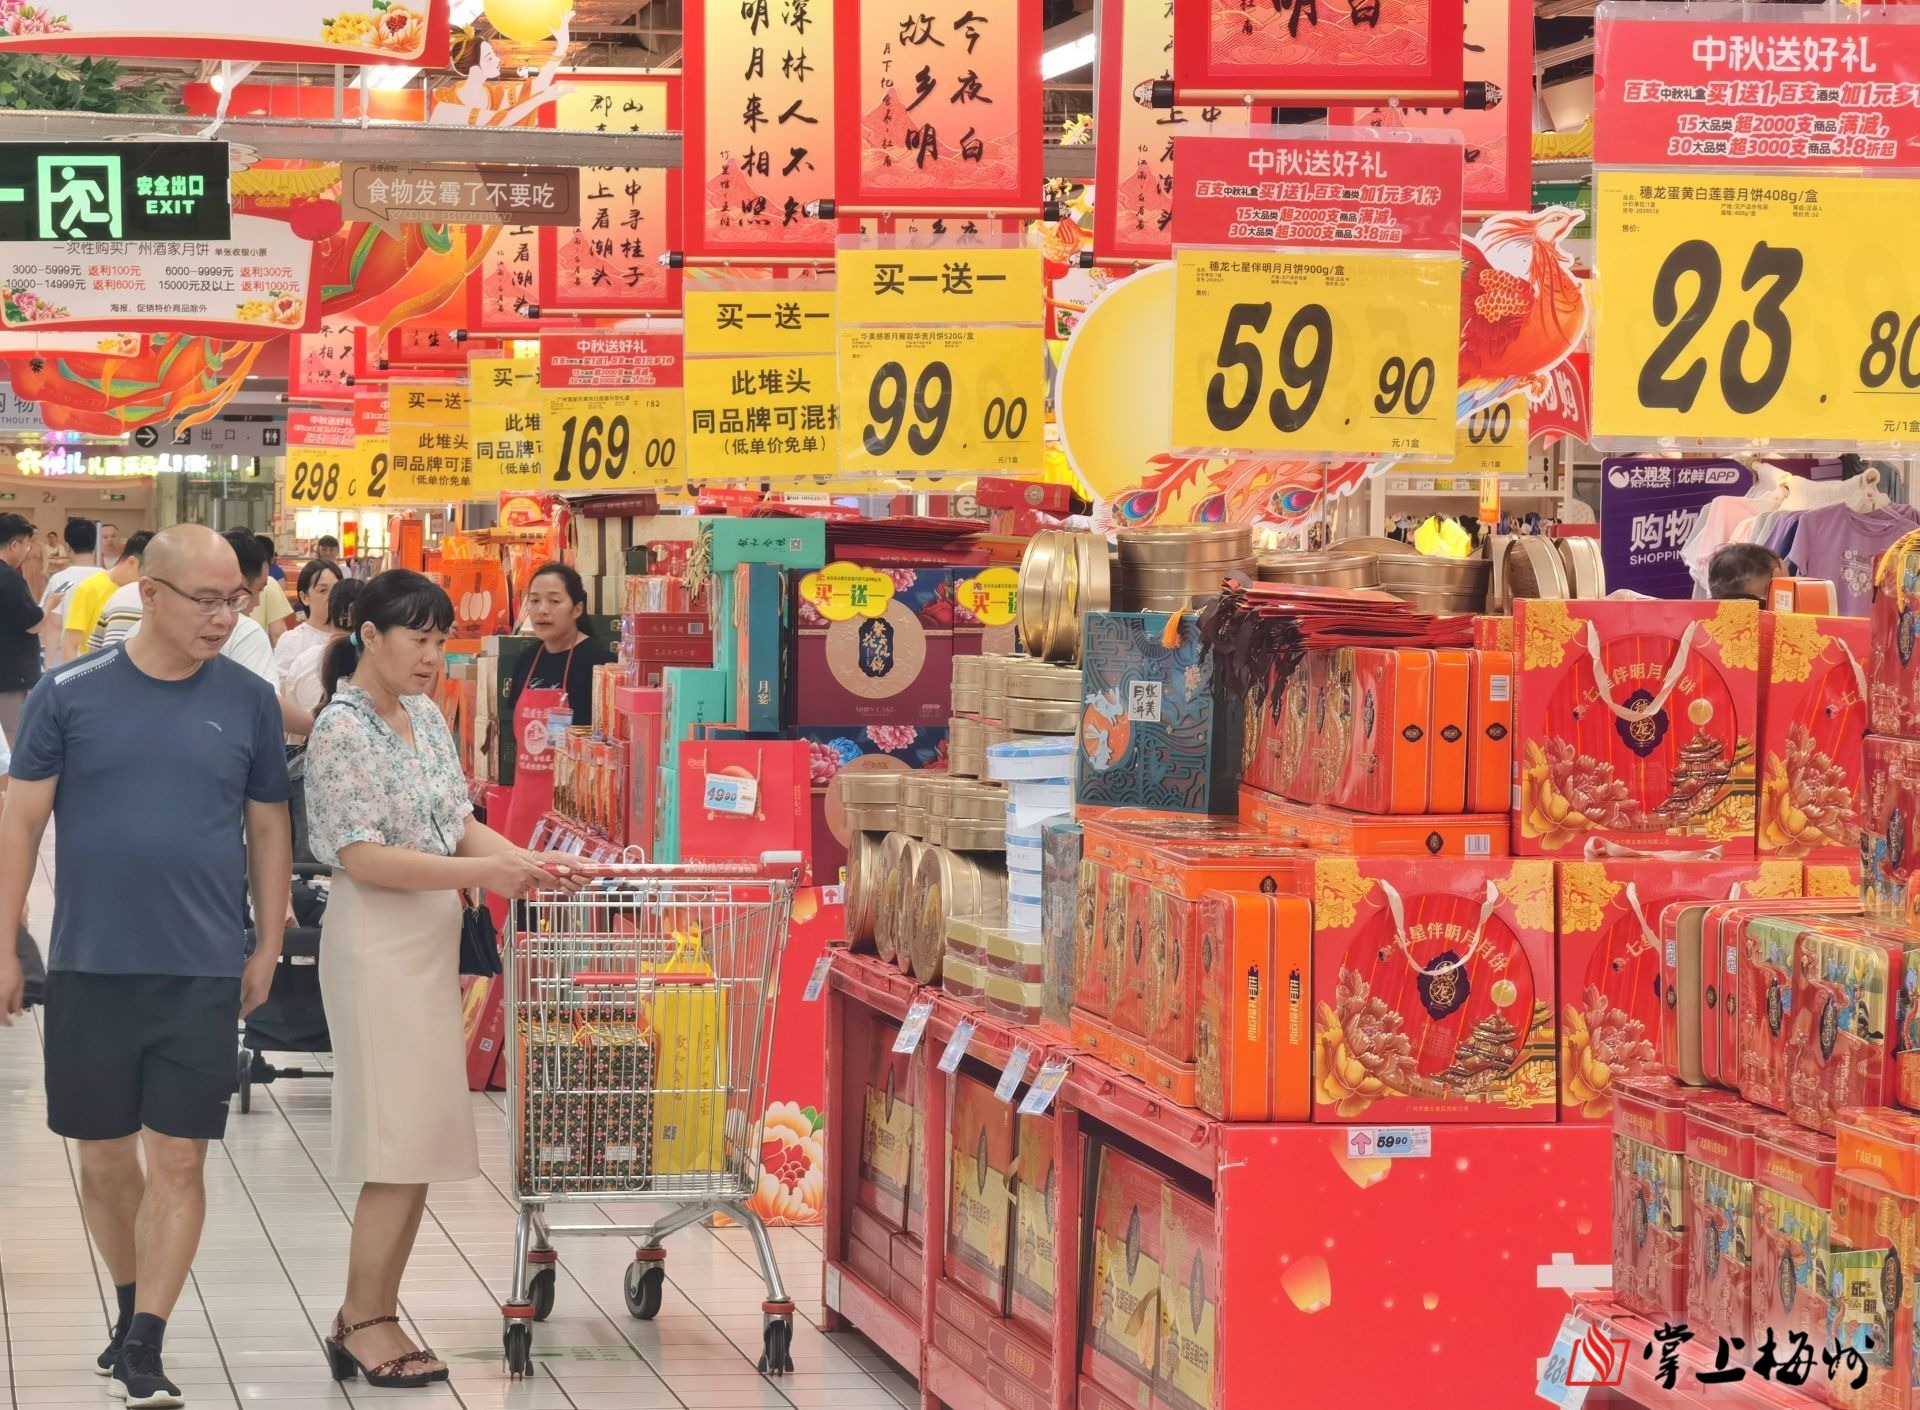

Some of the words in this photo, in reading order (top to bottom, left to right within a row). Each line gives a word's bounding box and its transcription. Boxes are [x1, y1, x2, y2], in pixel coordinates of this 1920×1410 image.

[1692, 35, 1877, 73] 中秋送好礼
[899, 13, 945, 169] 故乡明
[950, 11, 993, 163] 今夜白
[1249, 148, 1388, 179] 中秋送好礼
[137, 175, 204, 196] 安全出口
[367, 177, 555, 209] 食物发霉了不要吃
[1640, 185, 1818, 204] 穗龙蛋黄白莲蓉月饼408g/盒
[146, 201, 195, 214] EXIT
[442, 210, 513, 223] KNOW
[1622, 224, 1640, 232] 售价:
[53, 241, 209, 256] 一次性购买广州酒家月饼
[215, 247, 268, 257] 单张收银小票
[12, 264, 82, 276] 3000-5999元
[88, 265, 142, 276] 返利100元
[165, 266, 234, 278] 6000-9999元
[240, 266, 293, 278] 返利300元
[1209, 261, 1345, 276] 穗龙七星伴明月月饼900g/盒
[159, 280, 236, 292] 15000元及以上
[241, 281, 301, 292] 返利1000元
[874, 262, 1006, 296] 买一送一
[716, 303, 830, 330] 买一送一
[577, 339, 647, 354] 中秋送好礼
[731, 368, 811, 396] 此堆头
[646, 400, 660, 408] 182
[0, 416, 29, 424] THOUT
[418, 433, 469, 451] 此堆头
[1391, 438, 1420, 449] 元/1盒
[1631, 466, 1671, 482] 大润发
[1678, 468, 1705, 485] 优鲜
[1708, 471, 1735, 482] APP
[1630, 509, 1698, 552] 购物
[1630, 550, 1683, 565] SHOPPIN
[815, 583, 886, 607] 买一送一
[876, 706, 895, 714] CAKE
